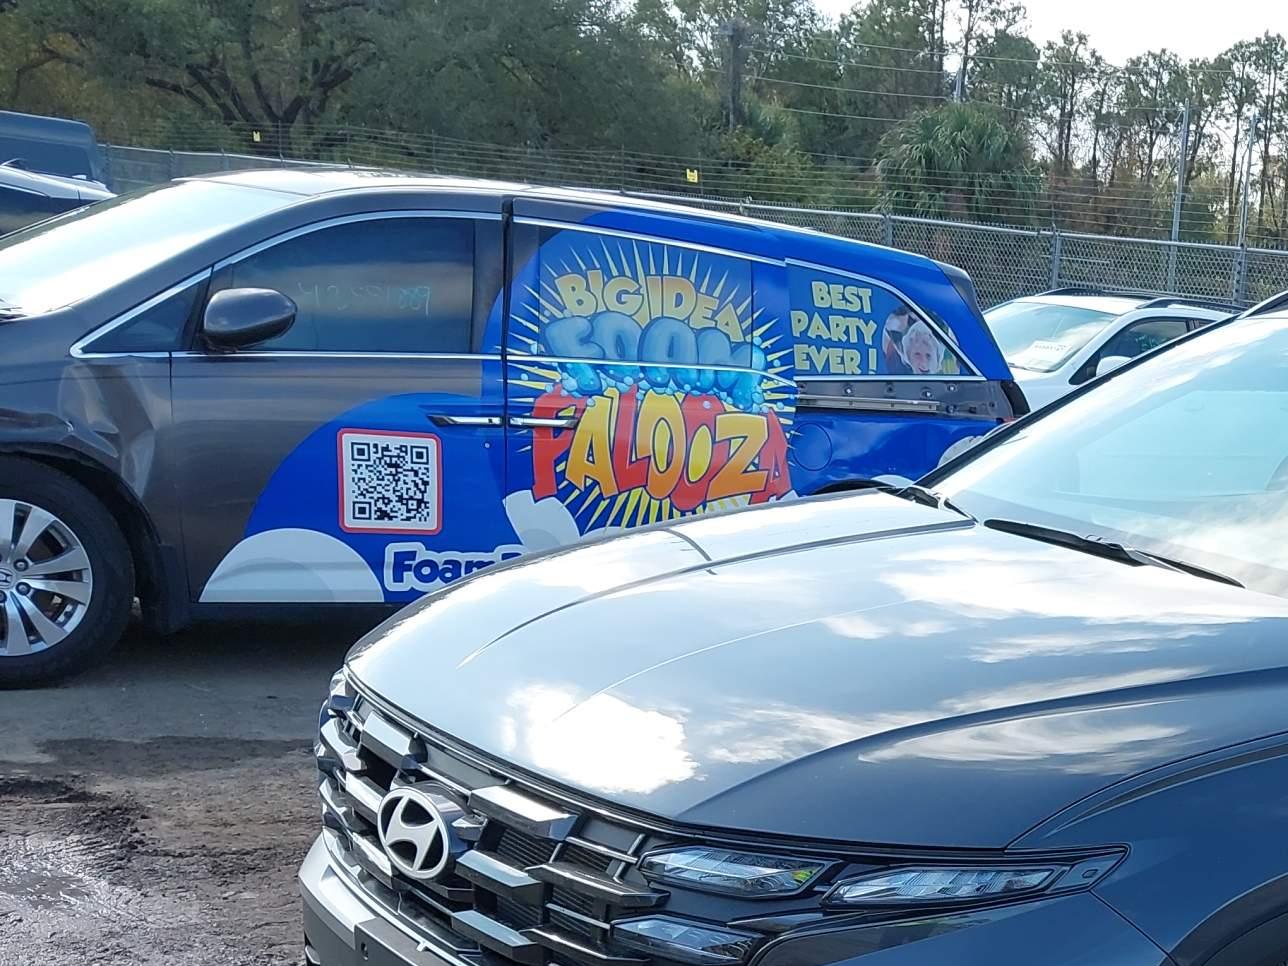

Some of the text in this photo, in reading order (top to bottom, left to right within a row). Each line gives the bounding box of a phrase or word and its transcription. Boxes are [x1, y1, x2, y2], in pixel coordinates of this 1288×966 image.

[554, 269, 744, 343] BIG IDEA
[811, 281, 872, 313] BEST
[790, 310, 877, 345] PARTY
[793, 344, 862, 374] EVER
[531, 384, 793, 512] PALOOZA
